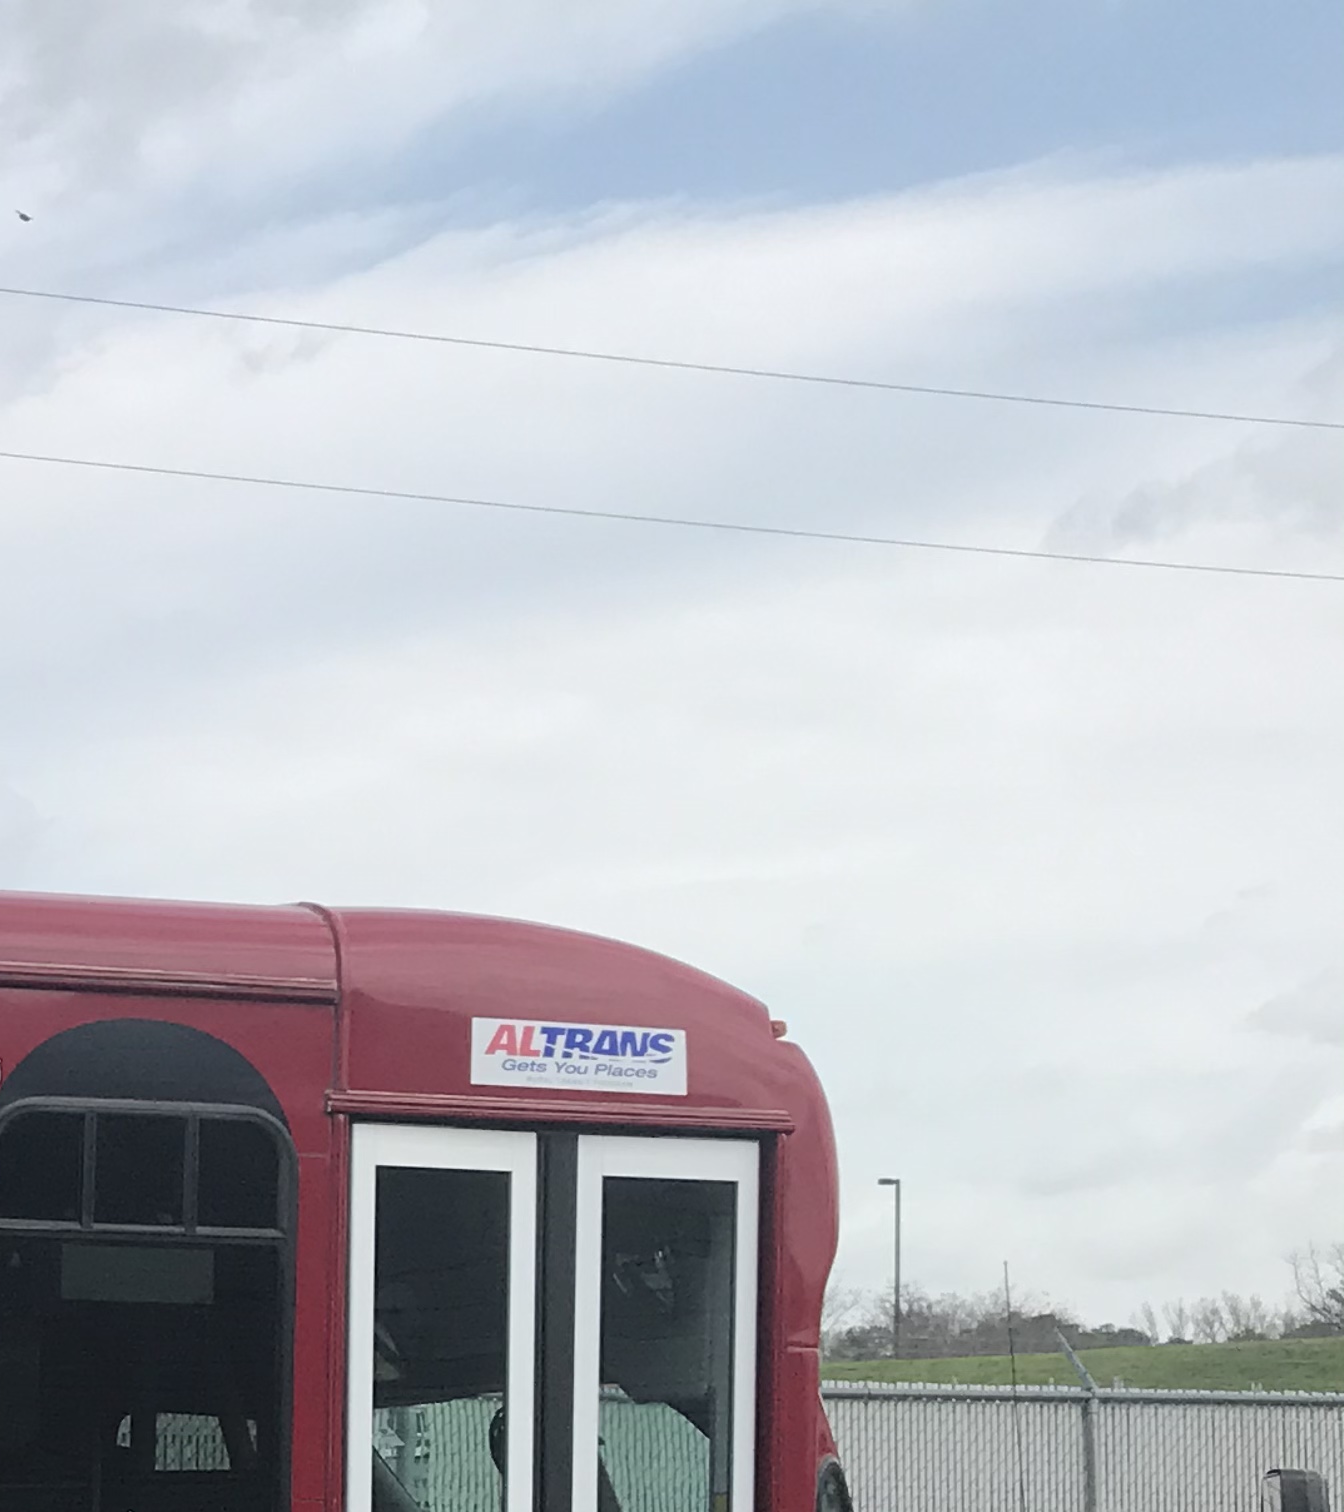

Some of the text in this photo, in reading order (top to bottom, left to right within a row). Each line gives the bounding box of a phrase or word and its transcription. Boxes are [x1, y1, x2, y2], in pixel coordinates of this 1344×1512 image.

[484, 1024, 676, 1064] ALTRANS
[501, 1058, 658, 1079] Gets You Places
